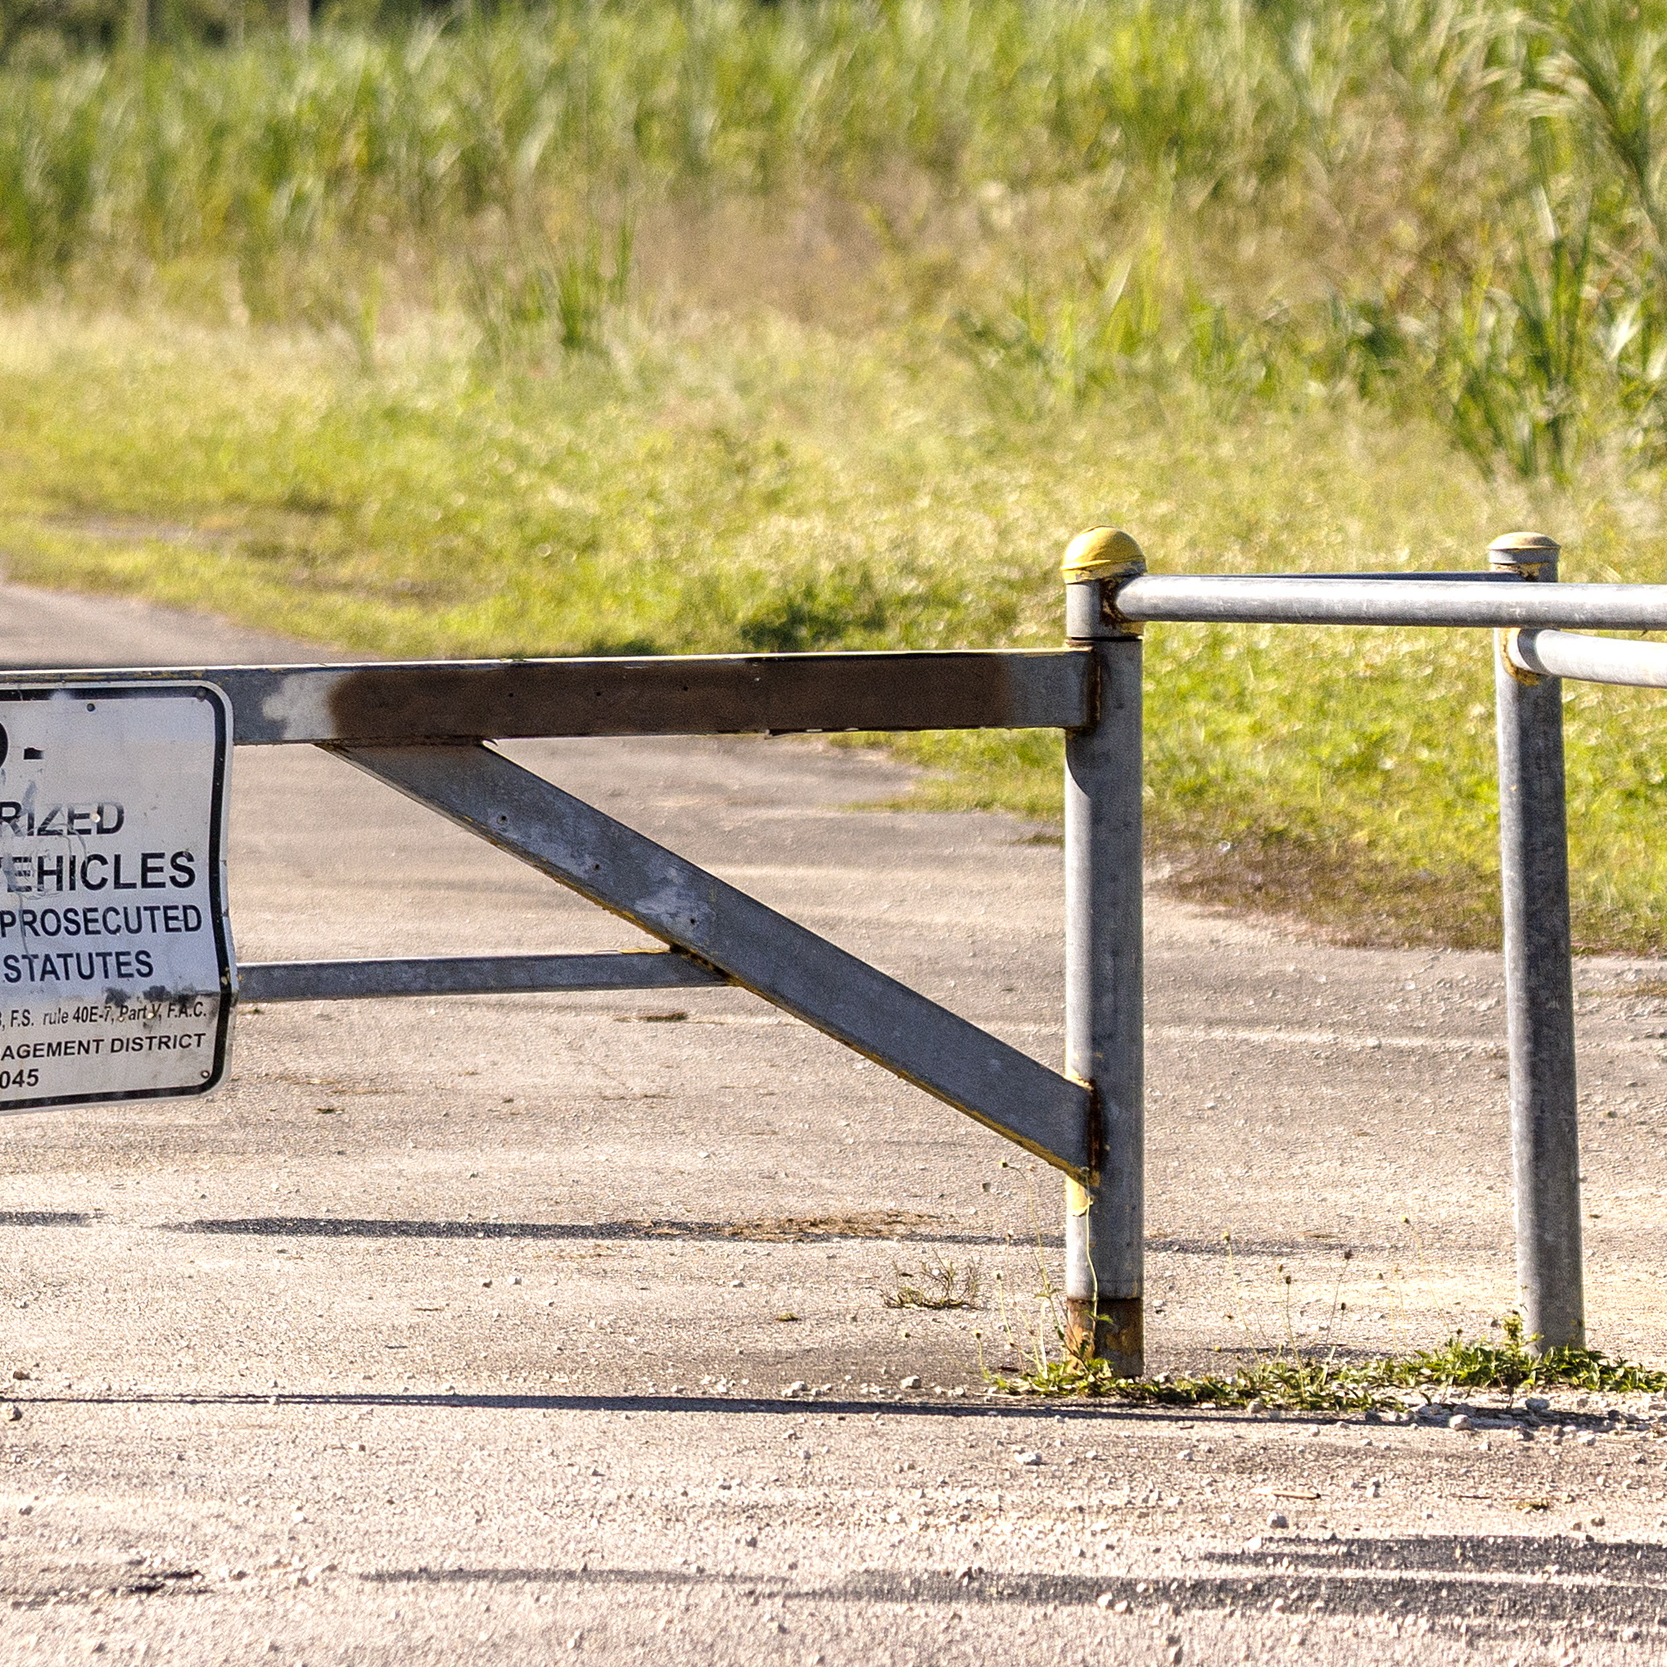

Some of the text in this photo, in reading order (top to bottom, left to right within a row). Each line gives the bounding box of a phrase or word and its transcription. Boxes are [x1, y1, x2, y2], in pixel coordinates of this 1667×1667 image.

[3, 949, 154, 983] STATUTES
[10, 1009, 35, 1027] F.S.
[43, 1007, 69, 1026] rule
[72, 1005, 115, 1024] 40E-7,
[118, 1004, 147, 1022] Part
[167, 1000, 207, 1019] F.A.C.
[110, 1033, 207, 1053] DISTRICT
